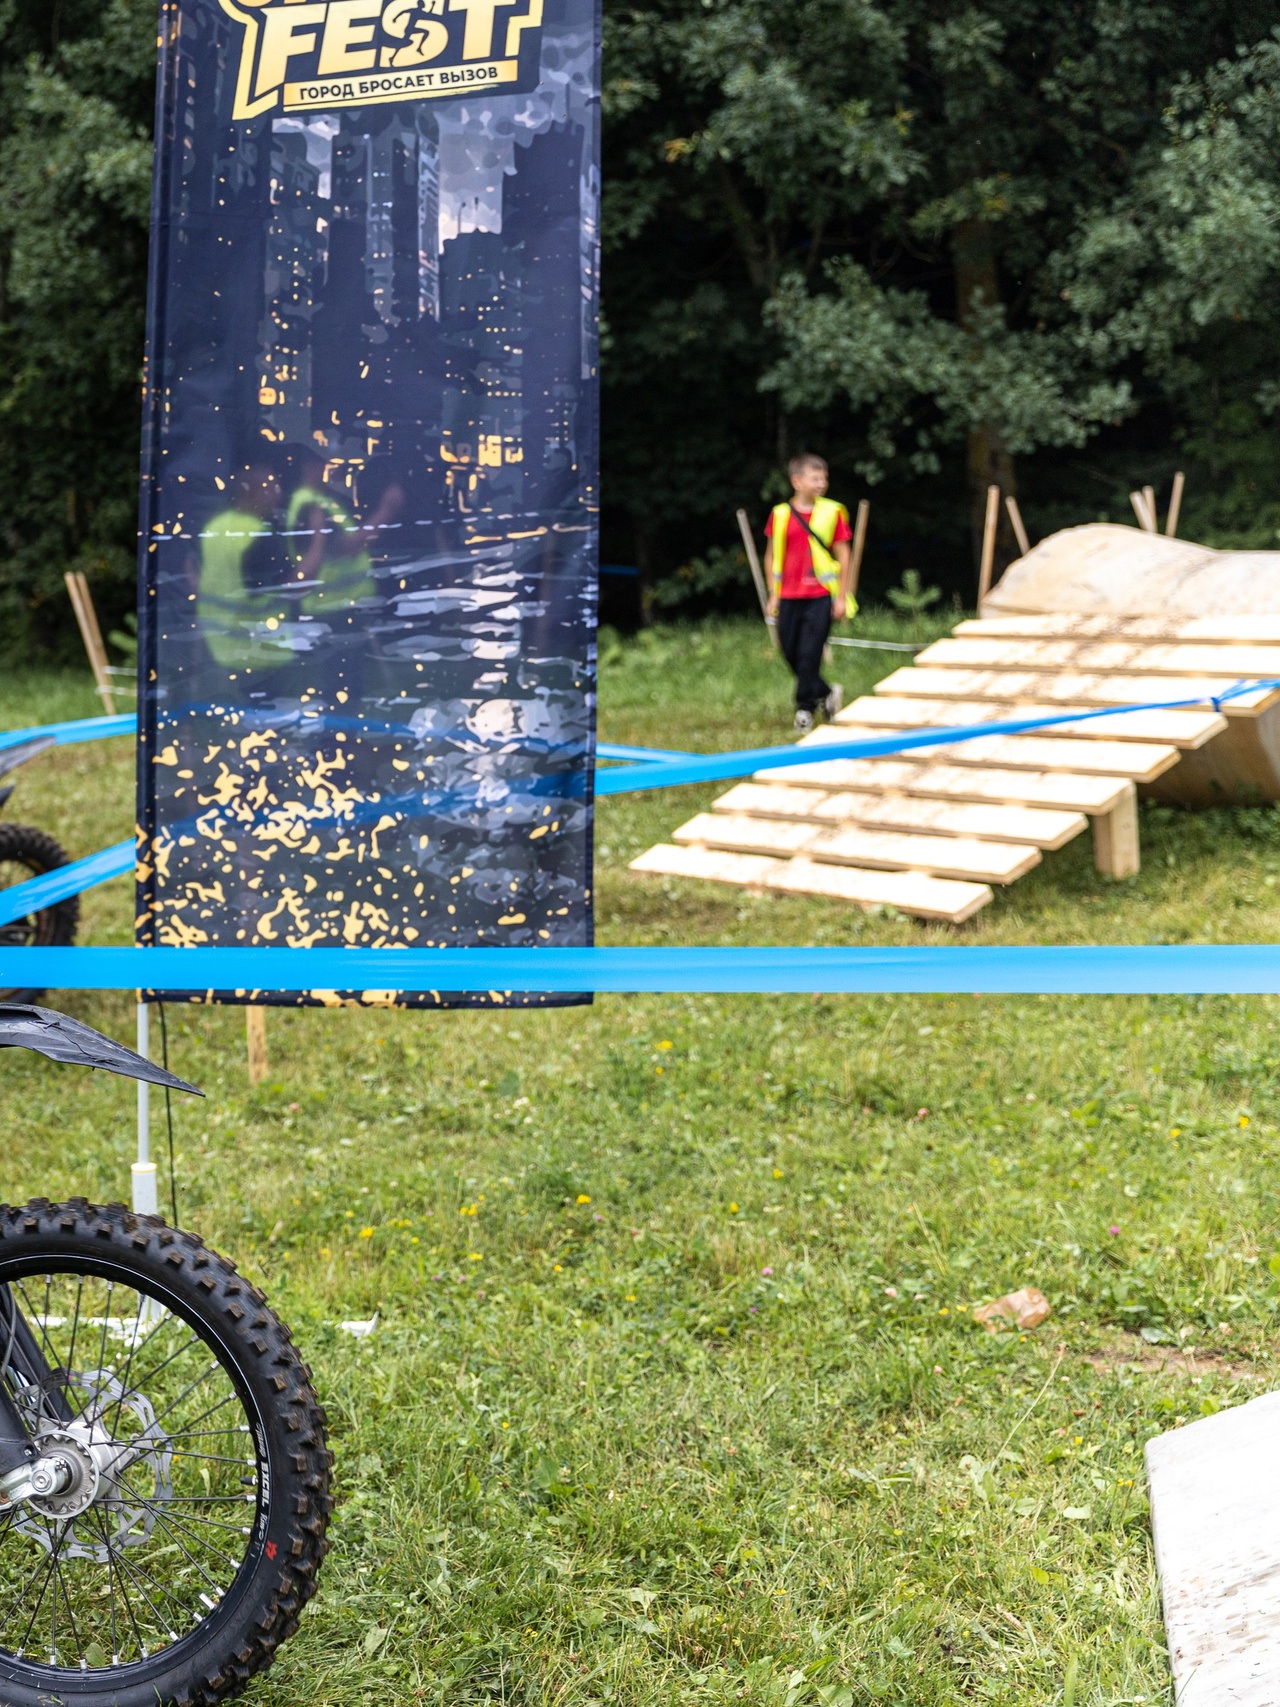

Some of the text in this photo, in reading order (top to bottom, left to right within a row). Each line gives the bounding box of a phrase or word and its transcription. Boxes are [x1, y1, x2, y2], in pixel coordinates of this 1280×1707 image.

[254, 0, 517, 97] FEST
[300, 66, 498, 100] ГОРОД БРОСАЕТ ВЫЗОВ
[260, 1461, 270, 1508] EXCEL
